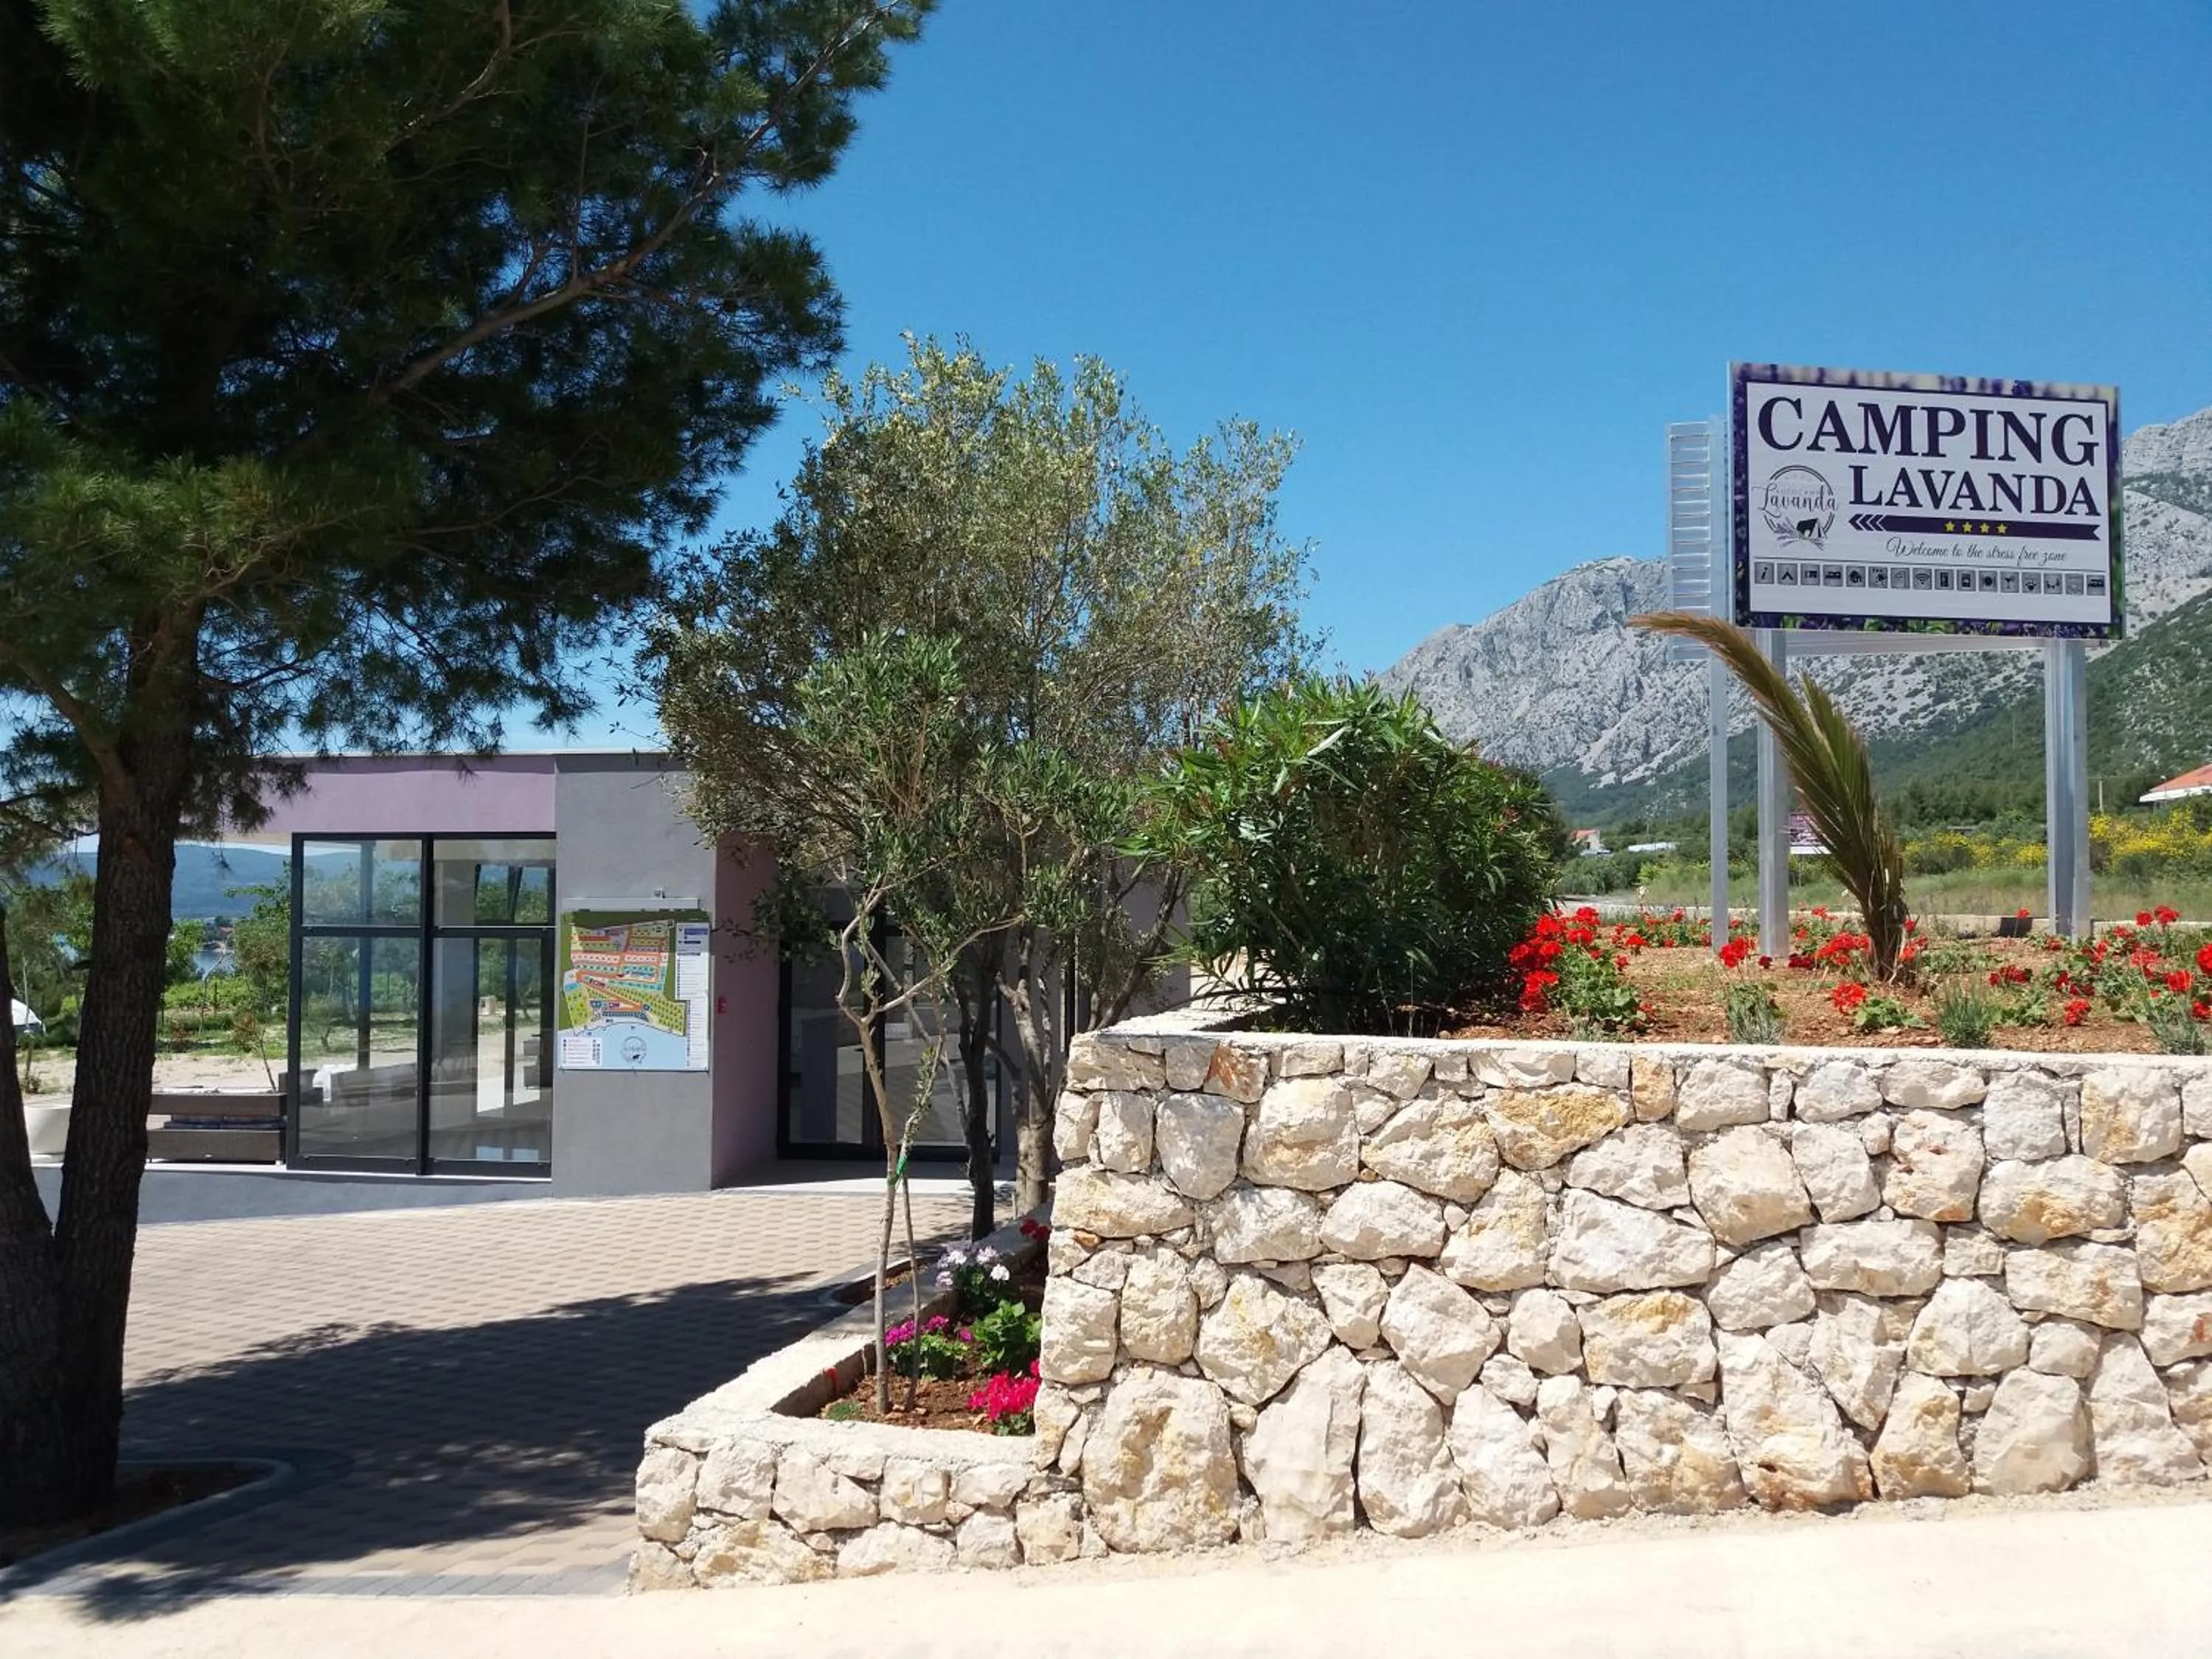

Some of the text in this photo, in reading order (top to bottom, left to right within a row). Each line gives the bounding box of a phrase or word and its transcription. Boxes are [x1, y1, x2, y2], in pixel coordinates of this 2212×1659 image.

[1758, 397, 2099, 467] CAMPING
[1752, 484, 1839, 518] Lavanda
[1848, 465, 2100, 516] LAVANDA
[1885, 536, 2066, 566] Welcome to the stress free zone
